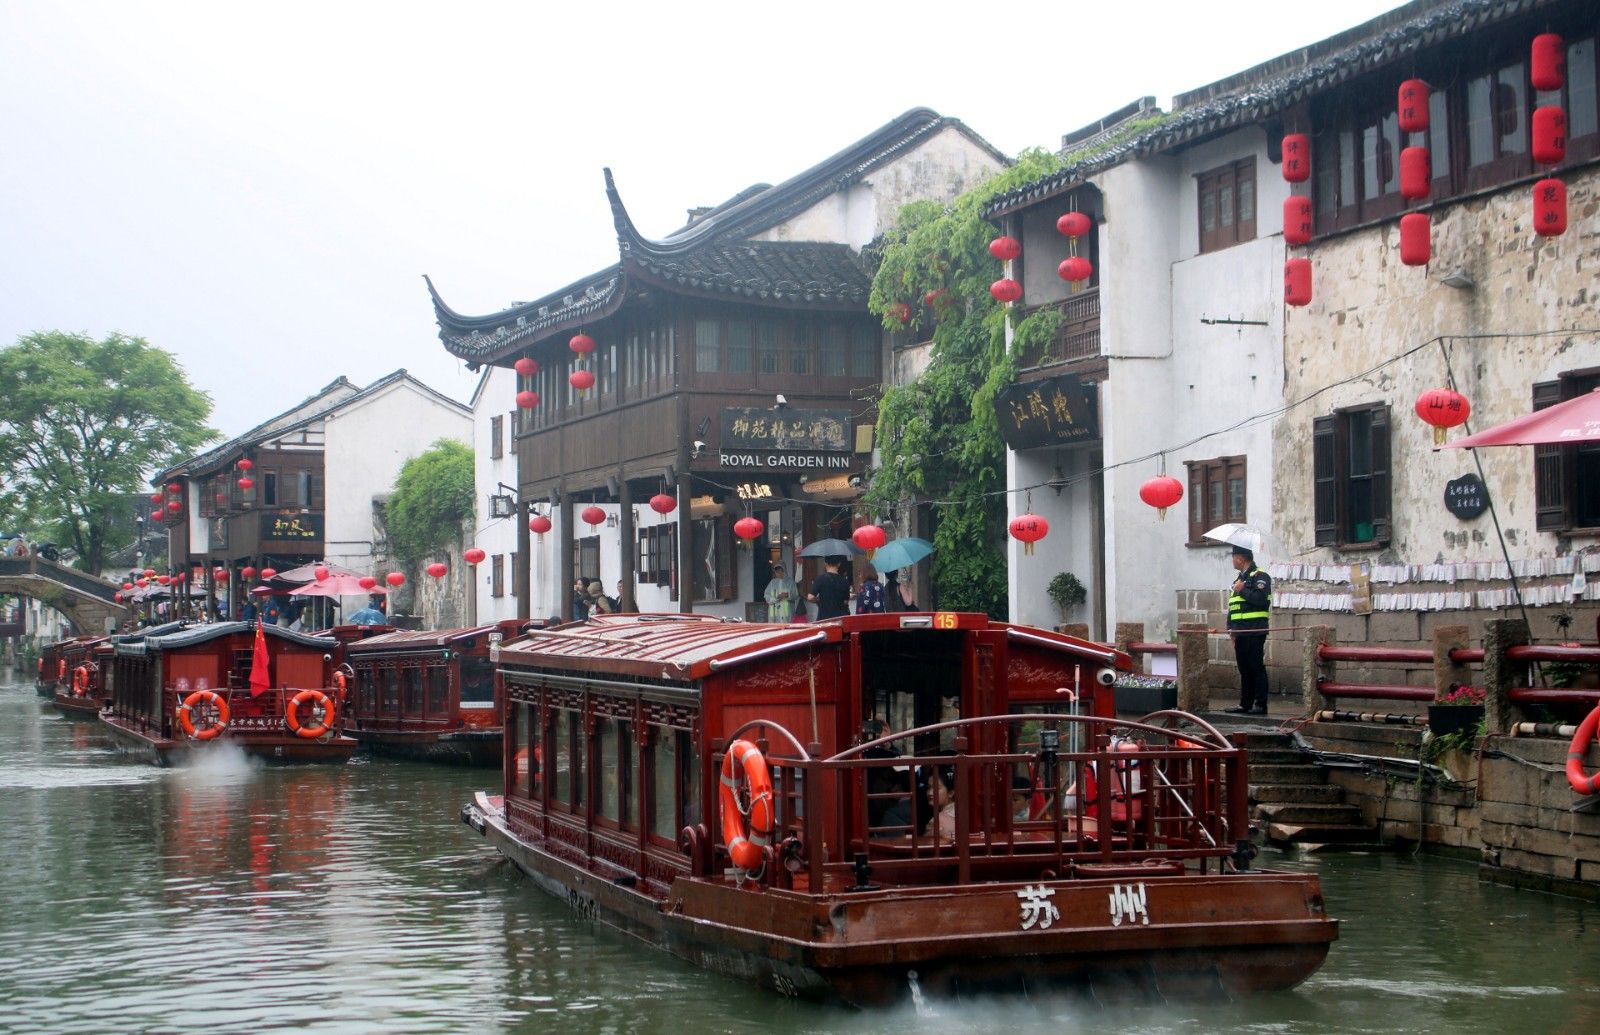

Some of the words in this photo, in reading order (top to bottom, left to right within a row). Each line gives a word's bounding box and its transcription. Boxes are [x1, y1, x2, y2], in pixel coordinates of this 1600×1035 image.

[1429, 396, 1461, 412] 山塘
[720, 454, 763, 467] ROYAL
[767, 455, 824, 468] GARDEN
[828, 457, 849, 468] INN
[938, 614, 954, 629] 15
[1016, 882, 1150, 930] 苏州
